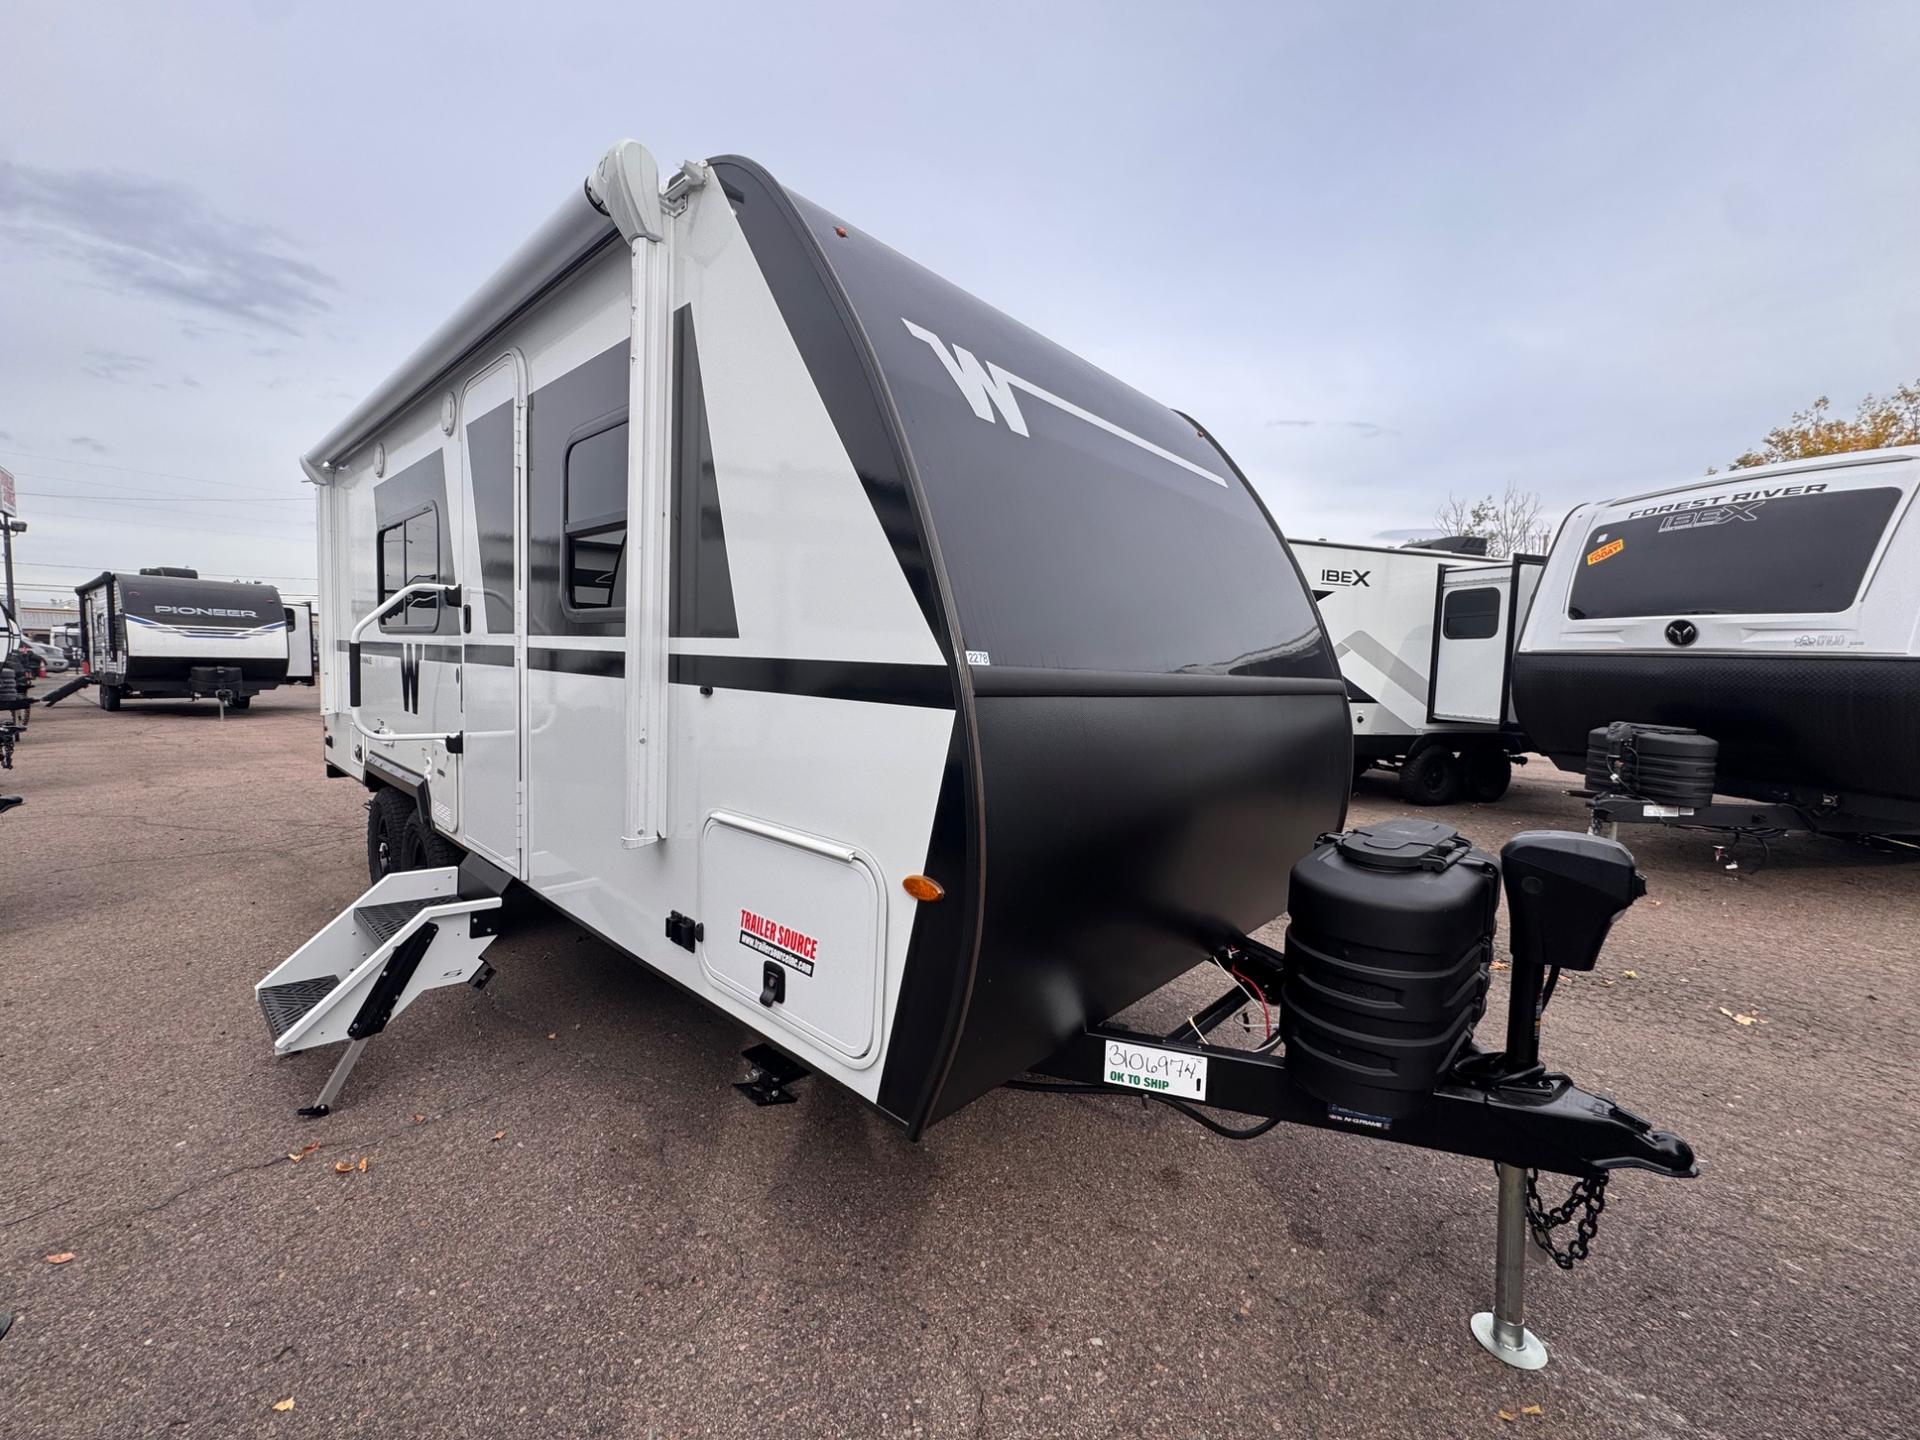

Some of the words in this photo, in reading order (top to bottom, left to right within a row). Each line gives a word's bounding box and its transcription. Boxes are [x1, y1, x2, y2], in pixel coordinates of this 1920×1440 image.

[1628, 495, 1726, 519] FOREST
[1731, 483, 1828, 503] RIVER
[1658, 501, 1766, 532] IBEX
[1321, 569, 1371, 587] IBEX
[154, 605, 259, 618] PIONEER
[968, 652, 989, 664] 2278
[741, 909, 777, 942] TRAILER
[778, 925, 818, 960] SOURCE
[1109, 1044, 1197, 1080] 3106974
[1110, 1070, 1125, 1083] OK
[1128, 1073, 1141, 1086] TO
[1143, 1076, 1170, 1090] SHIP
